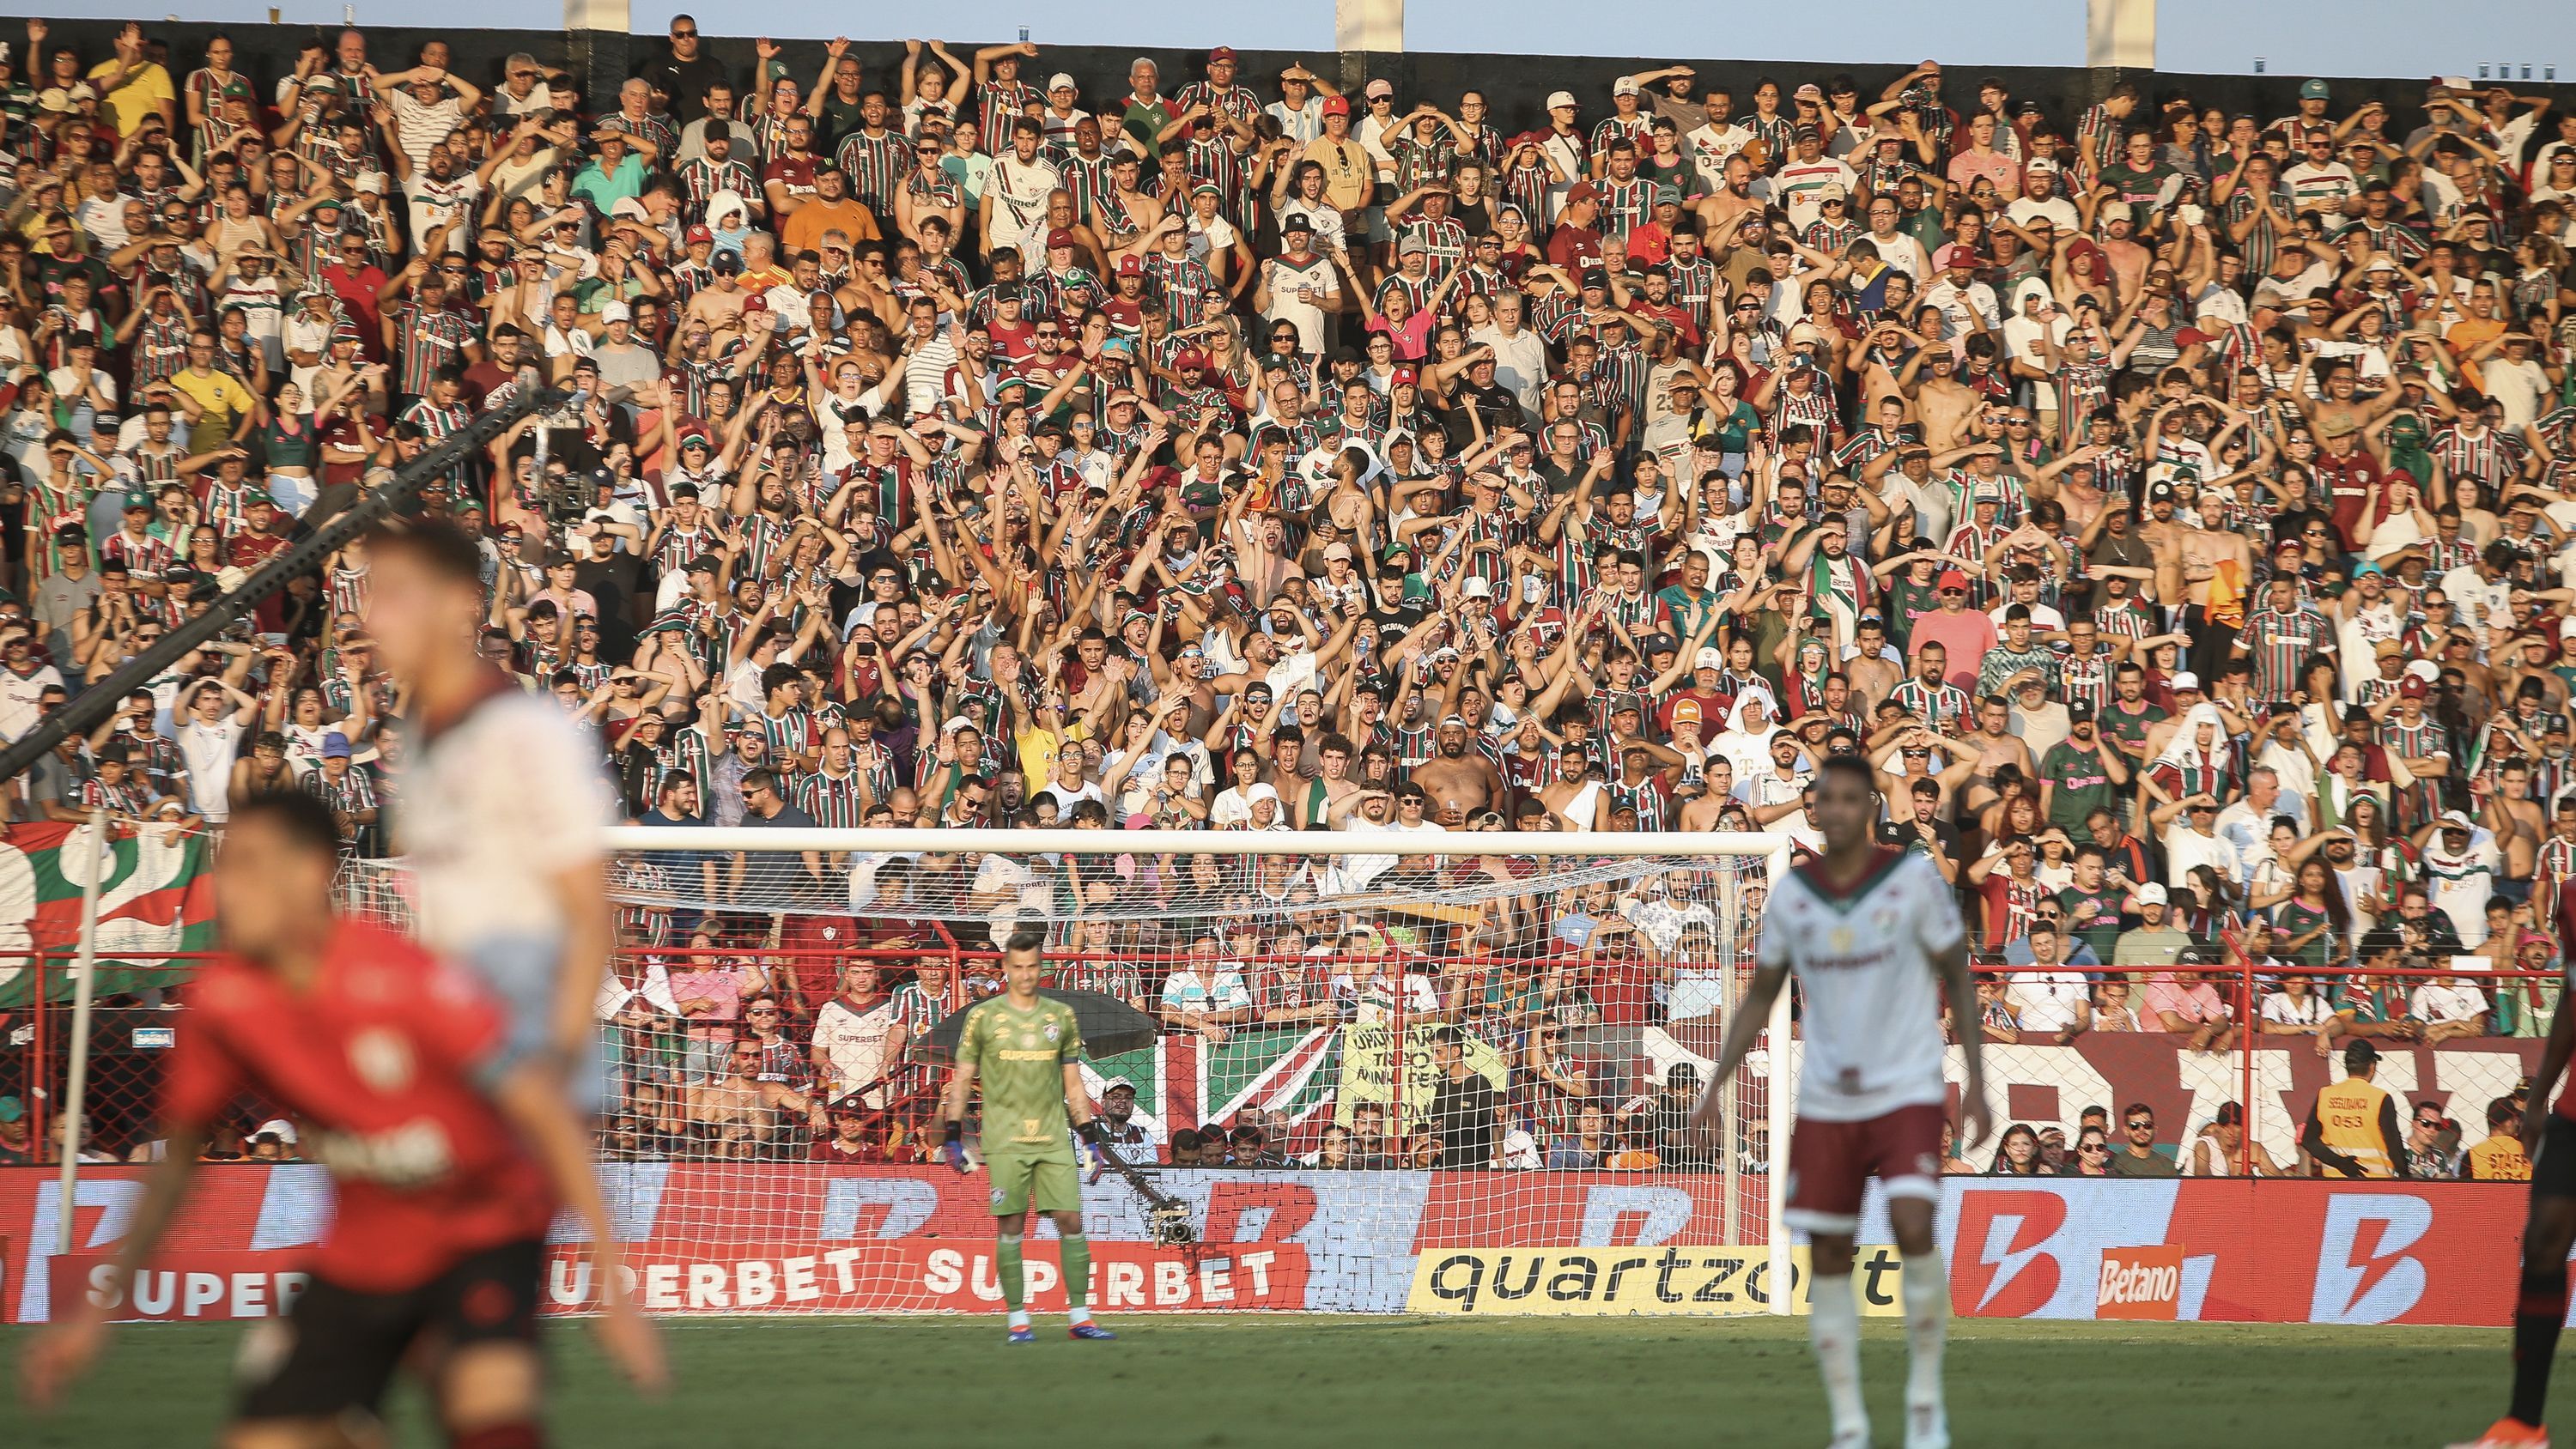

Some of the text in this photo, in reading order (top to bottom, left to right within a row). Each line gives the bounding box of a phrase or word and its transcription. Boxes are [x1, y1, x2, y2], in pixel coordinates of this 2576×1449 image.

[796, 186, 818, 195] BETA
[1285, 455, 1302, 464] BETA
[979, 757, 1002, 771] ETANO
[1400, 757, 1431, 768] BETAN
[838, 1034, 883, 1043] SUPERBET
[2332, 1115, 2364, 1129] 053
[549, 1247, 860, 1310] UPERBET
[1431, 1246, 1903, 1313] quartzot
[2099, 1258, 2178, 1307] Betano
